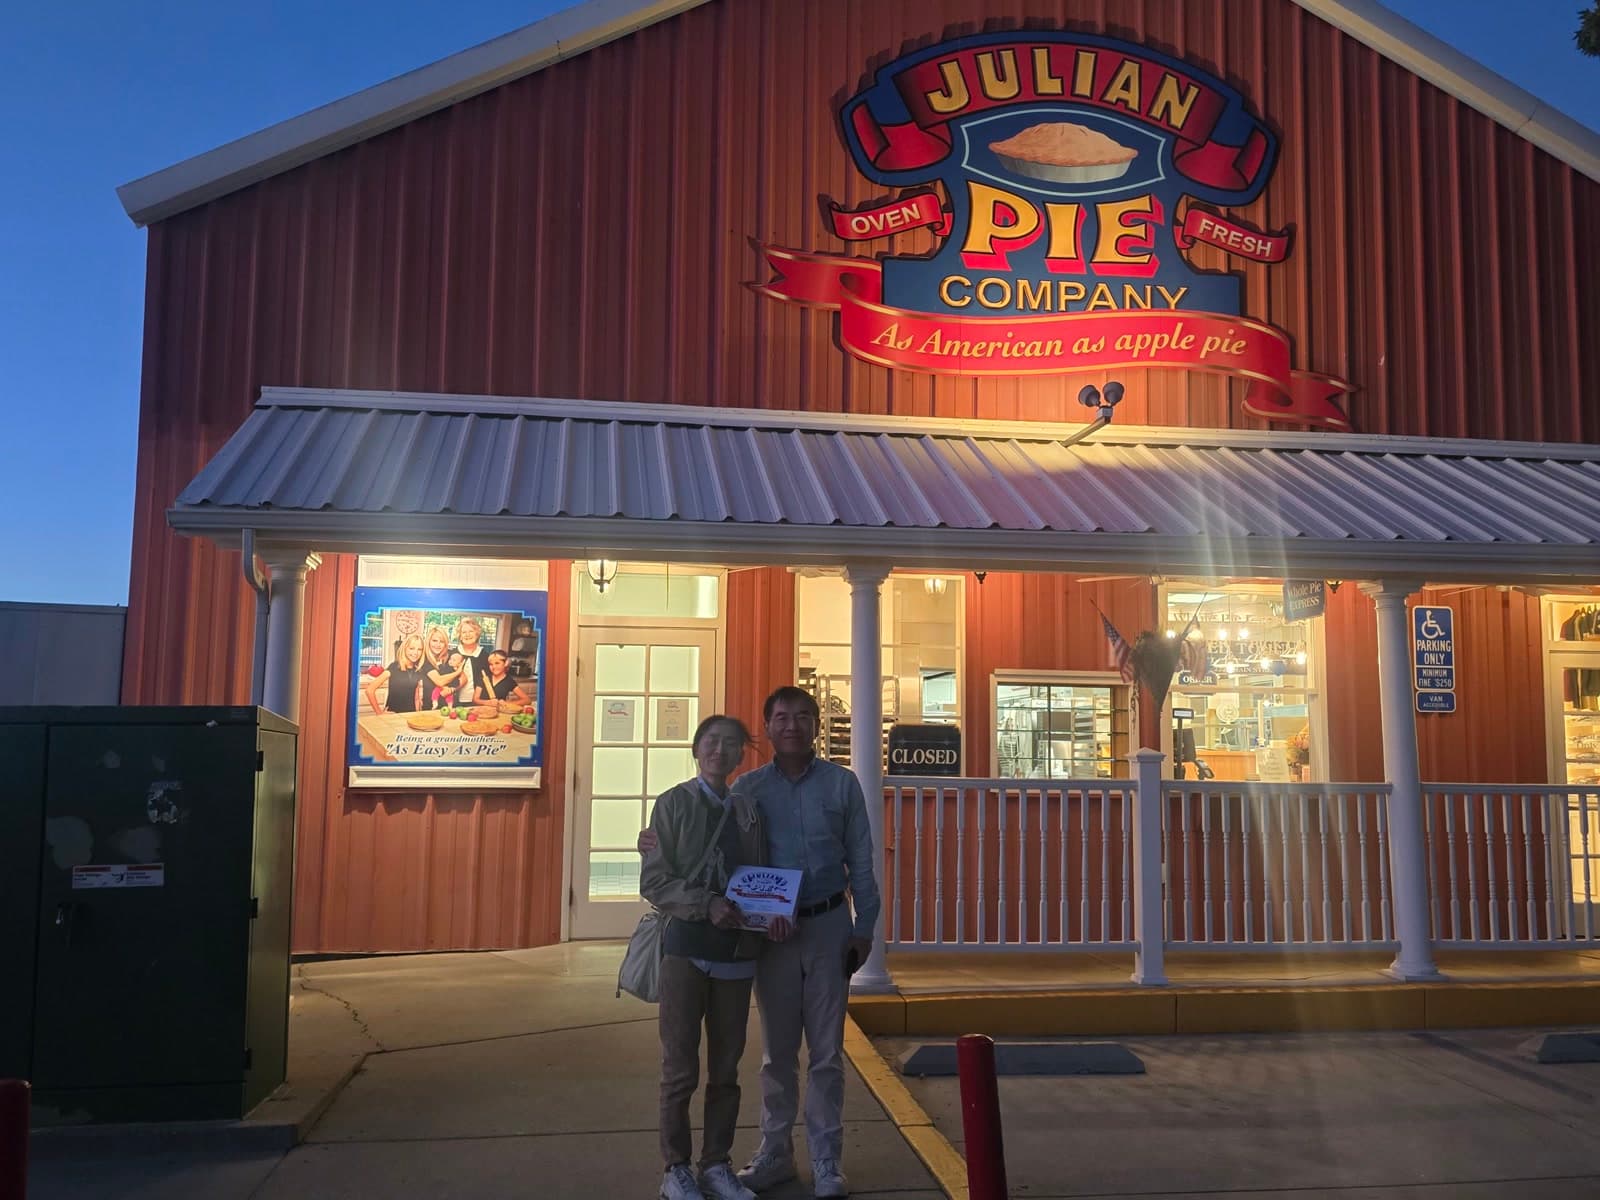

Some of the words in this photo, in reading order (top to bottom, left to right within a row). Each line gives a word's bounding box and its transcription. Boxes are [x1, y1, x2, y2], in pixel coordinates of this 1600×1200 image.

[926, 47, 1200, 130] JULIAN
[850, 202, 922, 238] OVEN
[960, 181, 1164, 278] PIE
[1198, 218, 1273, 258] FRESH
[938, 274, 1190, 312] COMPANY
[870, 322, 913, 350] As
[916, 328, 1064, 358] American
[1071, 334, 1105, 355] as
[1114, 322, 1197, 358] apple
[1199, 329, 1249, 358] pie
[1416, 639, 1452, 652] PARKING
[1424, 652, 1445, 665] ONLY
[1422, 669, 1447, 678] MINIMUM
[1418, 678, 1431, 687] FINE
[1435, 678, 1452, 687] $250
[396, 734, 423, 744] Being
[386, 743, 408, 755] "As
[413, 744, 449, 758] Easy
[452, 744, 472, 755] As
[475, 745, 507, 756] Pie"
[892, 748, 957, 764] CLOSED
